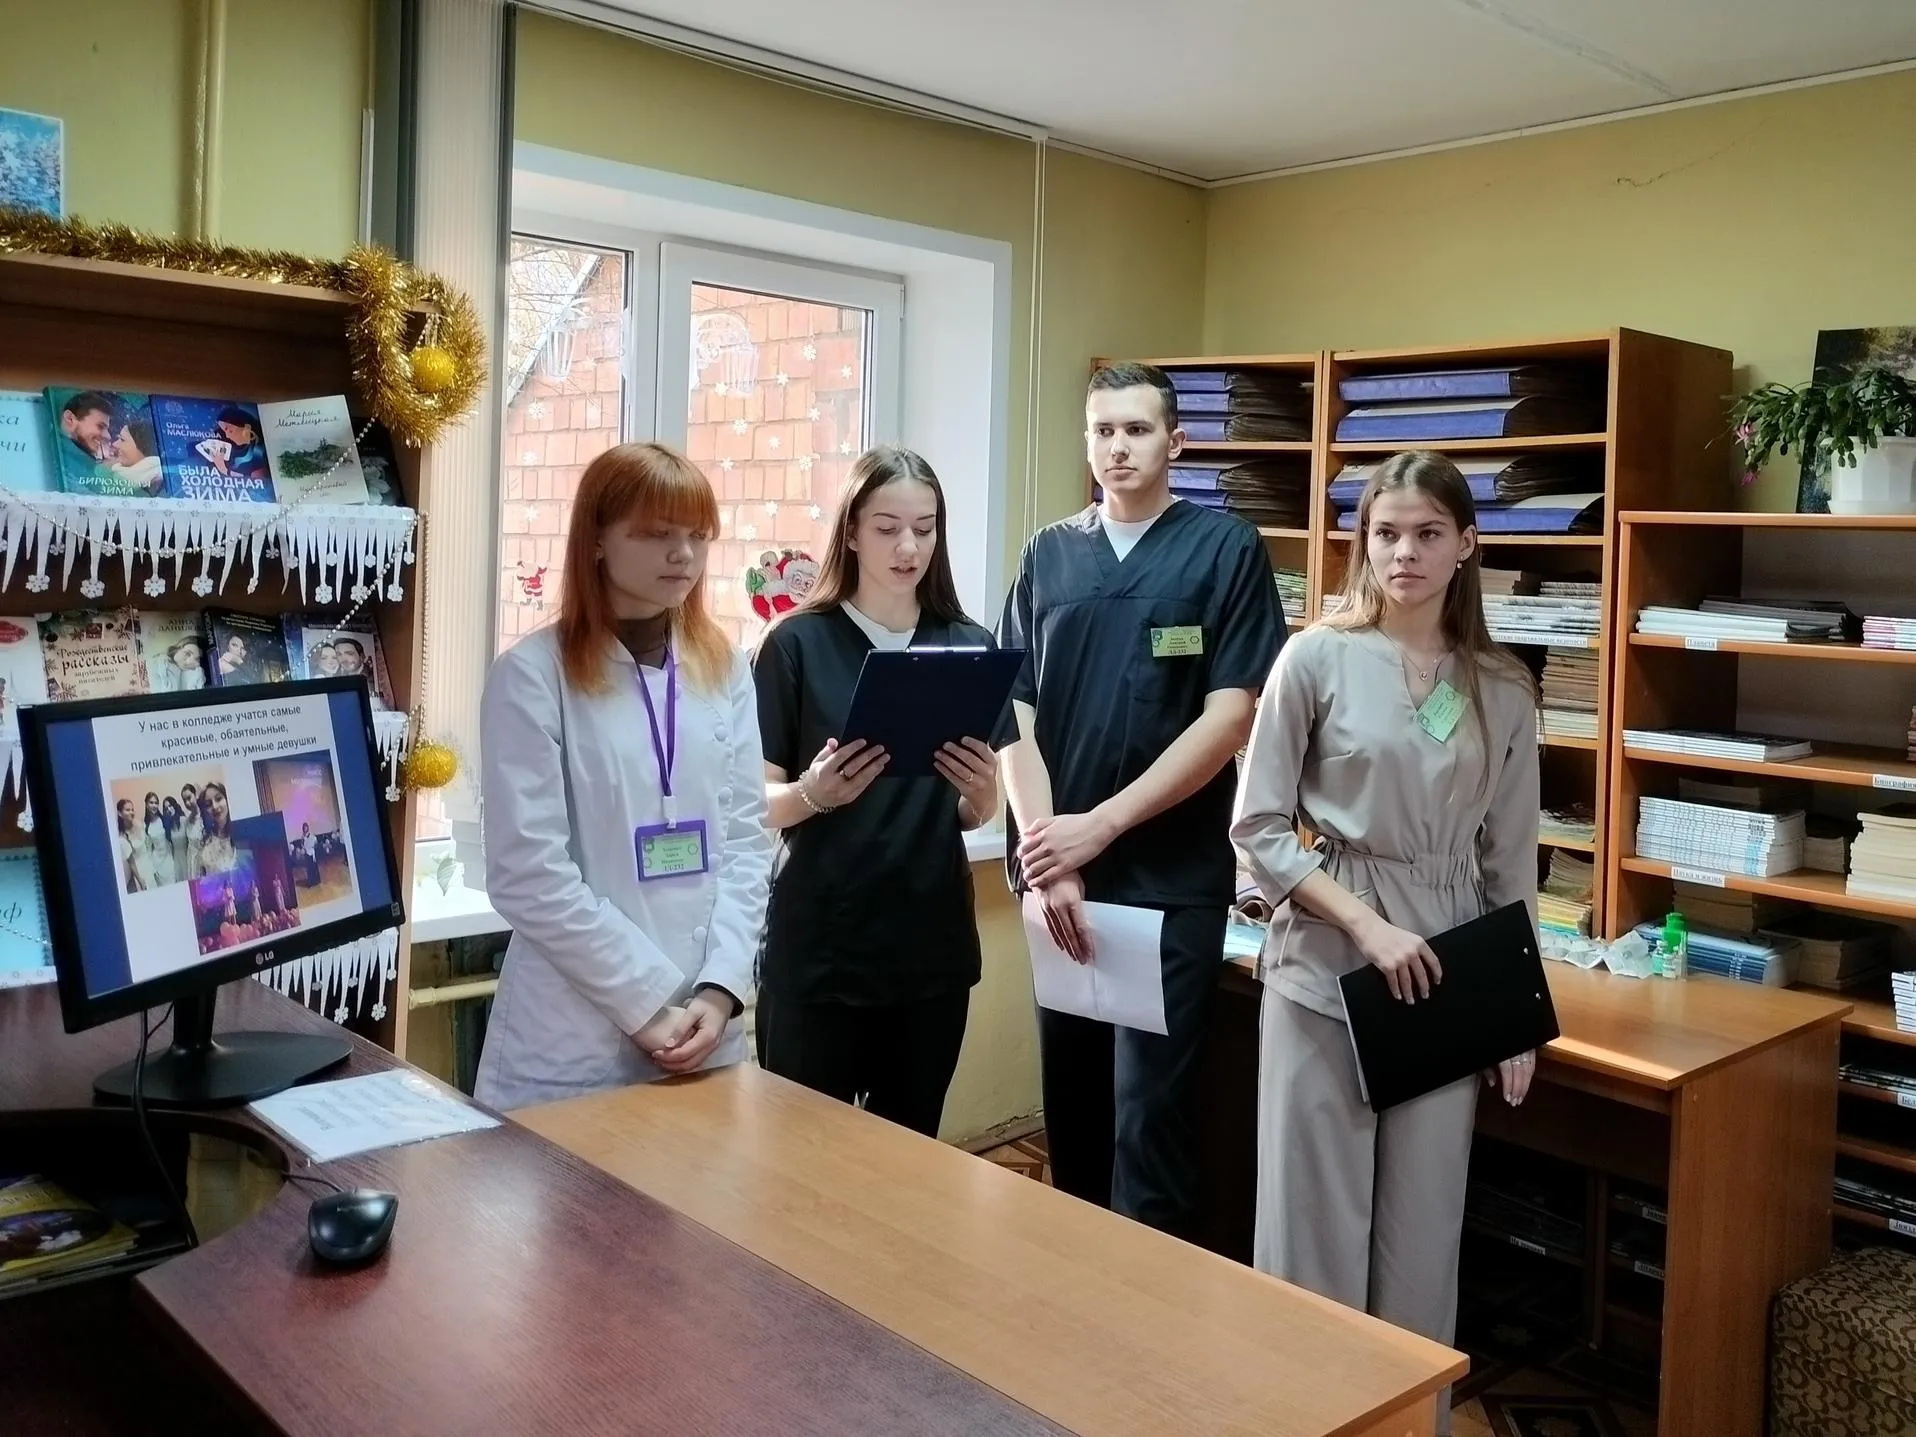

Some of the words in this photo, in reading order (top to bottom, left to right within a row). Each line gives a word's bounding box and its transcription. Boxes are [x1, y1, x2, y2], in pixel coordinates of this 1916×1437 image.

[166, 421, 190, 430] Ольга
[167, 428, 222, 440] МАСЛЮКОВА
[179, 464, 221, 477] БЫЛА
[181, 475, 265, 490] ХОЛОДНАЯ
[100, 486, 134, 496] ЗИМА
[182, 486, 253, 502] ЗИМА
[61, 654, 129, 677] рассказы
[138, 721, 146, 733] У
[149, 718, 169, 732] нас
[172, 720, 179, 729] в
[182, 713, 233, 729] колледже
[235, 710, 268, 725] учатся
[270, 704, 301, 717] самые
[161, 733, 218, 750] красивые,
[220, 724, 289, 742] обаятельные,
[130, 750, 230, 773] привлекательные
[232, 747, 240, 756] и
[241, 743, 275, 758] умные
[277, 735, 317, 751] девушки
